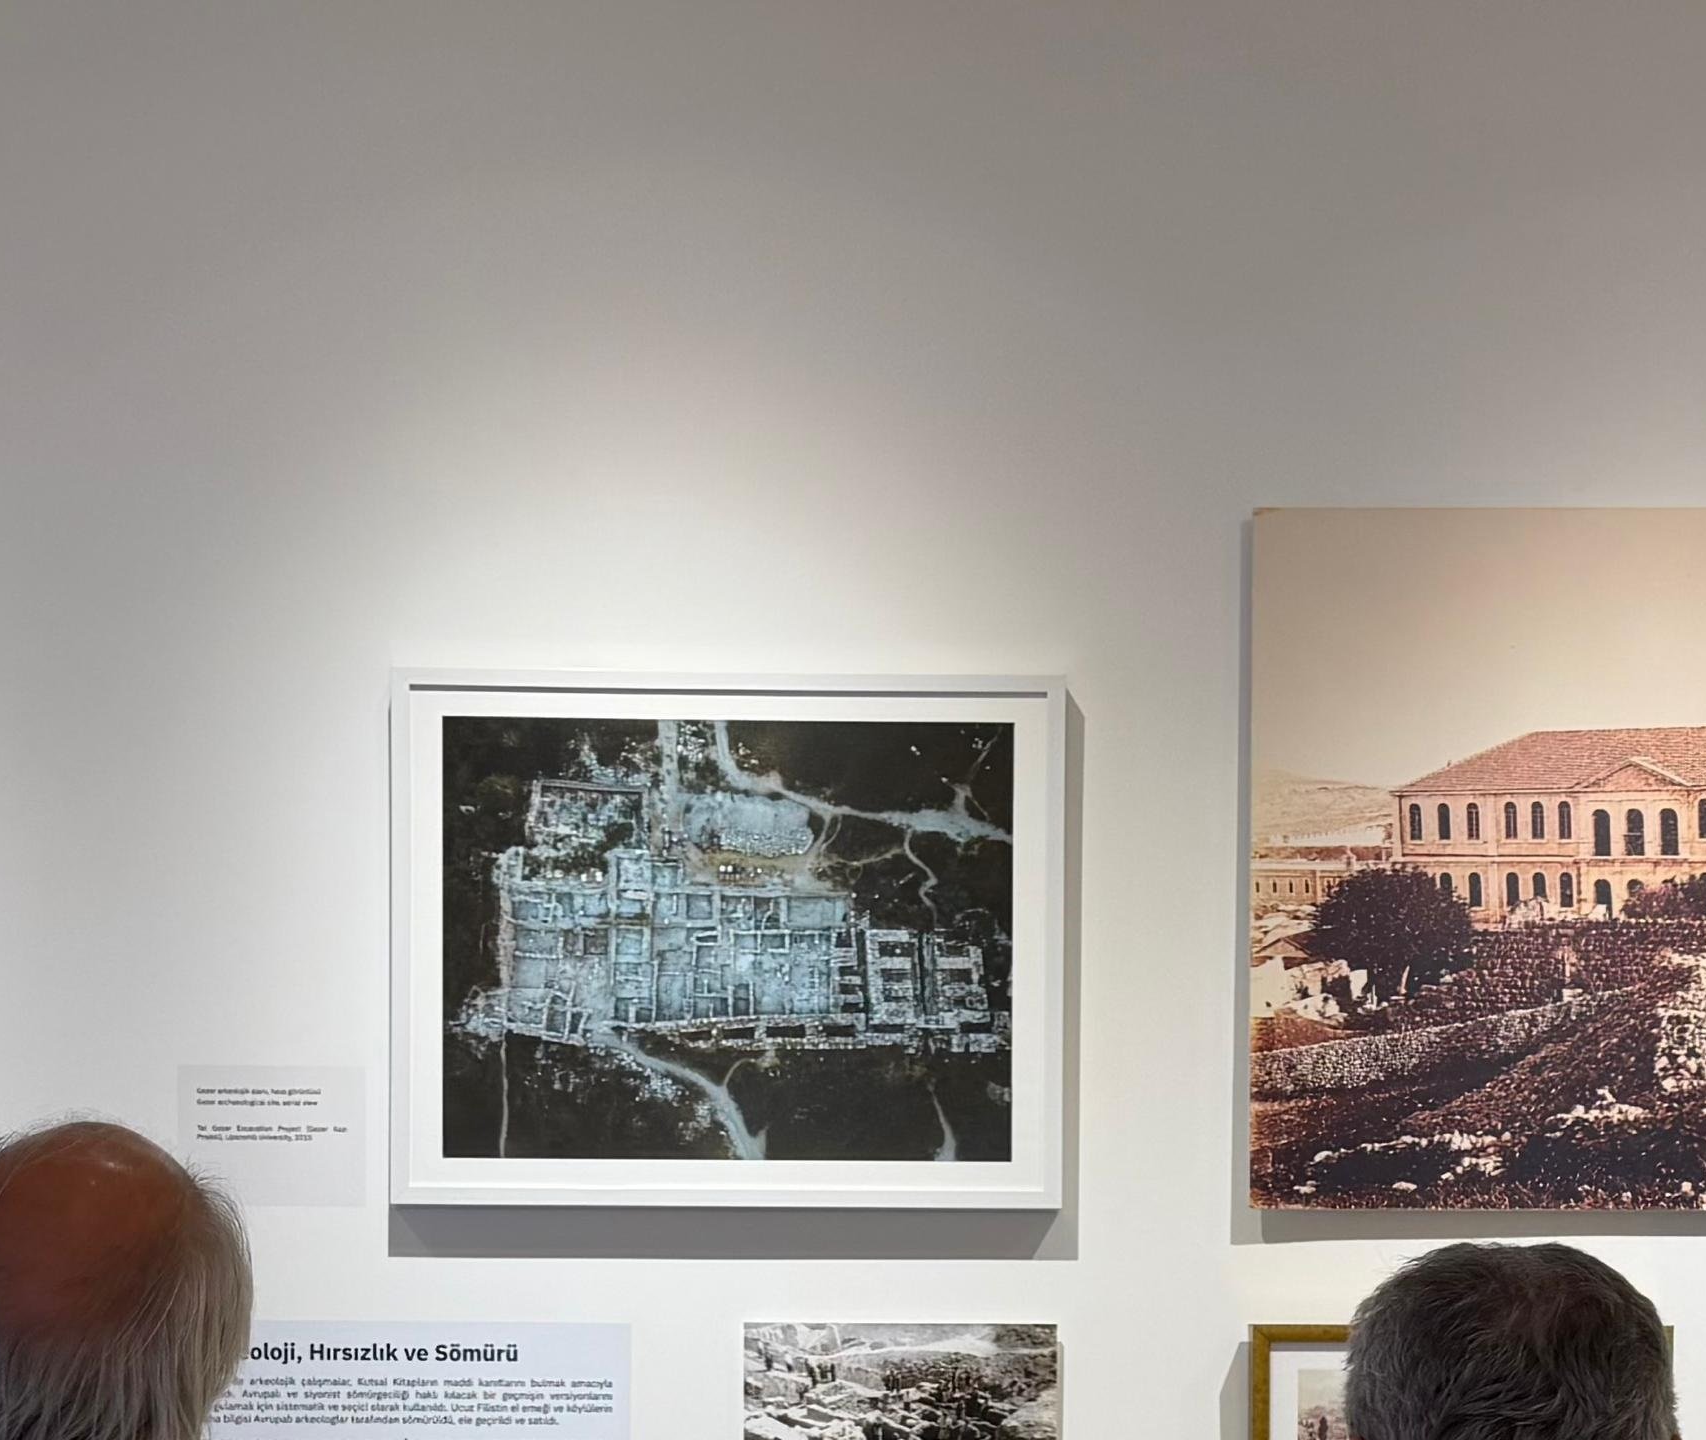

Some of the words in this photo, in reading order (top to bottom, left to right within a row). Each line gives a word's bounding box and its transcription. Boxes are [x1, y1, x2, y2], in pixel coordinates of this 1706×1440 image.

[250, 1342, 302, 1364] oloji,
[309, 1342, 399, 1362] Hırsızlık
[403, 1347, 429, 1362] ve
[434, 1343, 519, 1362] Sömürü
